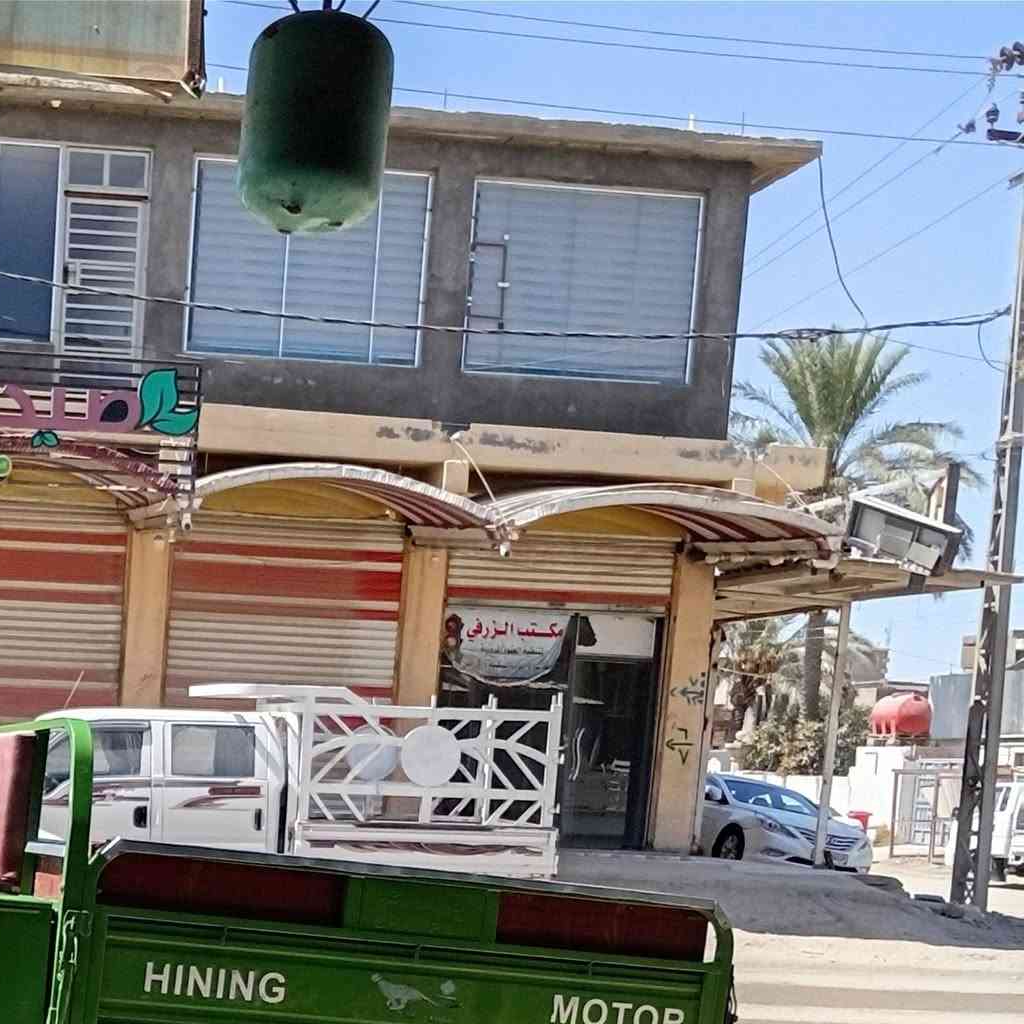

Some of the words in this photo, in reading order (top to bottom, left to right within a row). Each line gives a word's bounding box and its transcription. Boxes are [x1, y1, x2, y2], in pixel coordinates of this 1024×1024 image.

[466, 617, 514, 642] الزرفي
[517, 621, 564, 641] مكتب
[143, 961, 288, 1004] HINING
